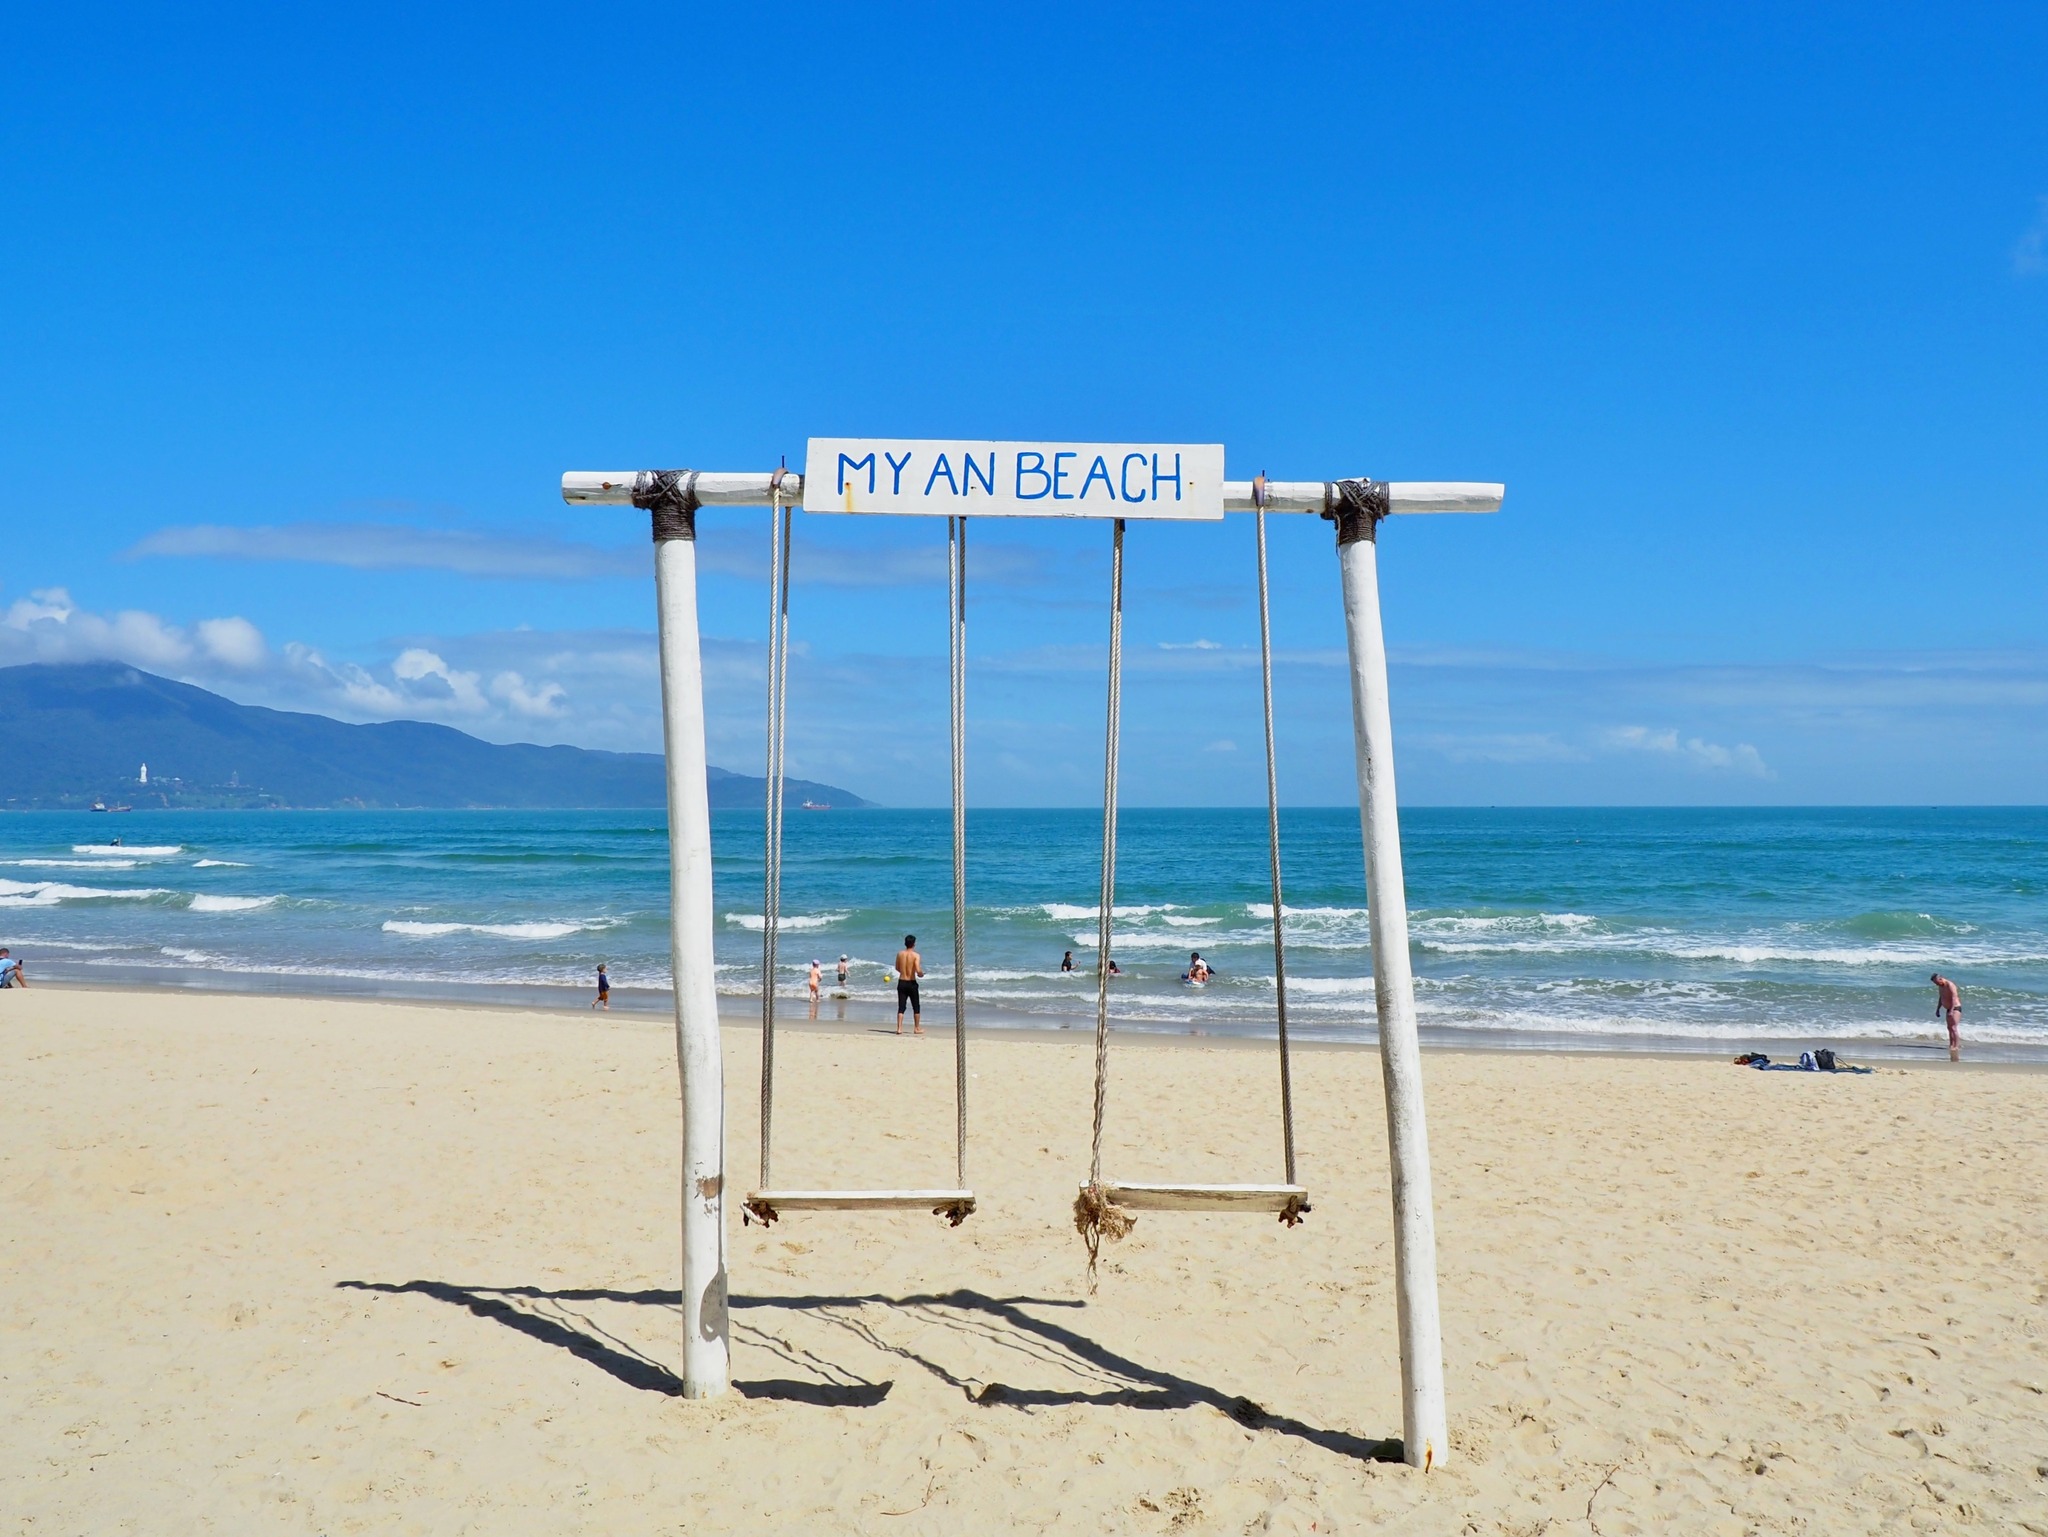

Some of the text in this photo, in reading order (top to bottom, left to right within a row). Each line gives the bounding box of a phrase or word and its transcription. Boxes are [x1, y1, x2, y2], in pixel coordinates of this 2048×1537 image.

[837, 451, 1182, 504] MY AN BEACH
